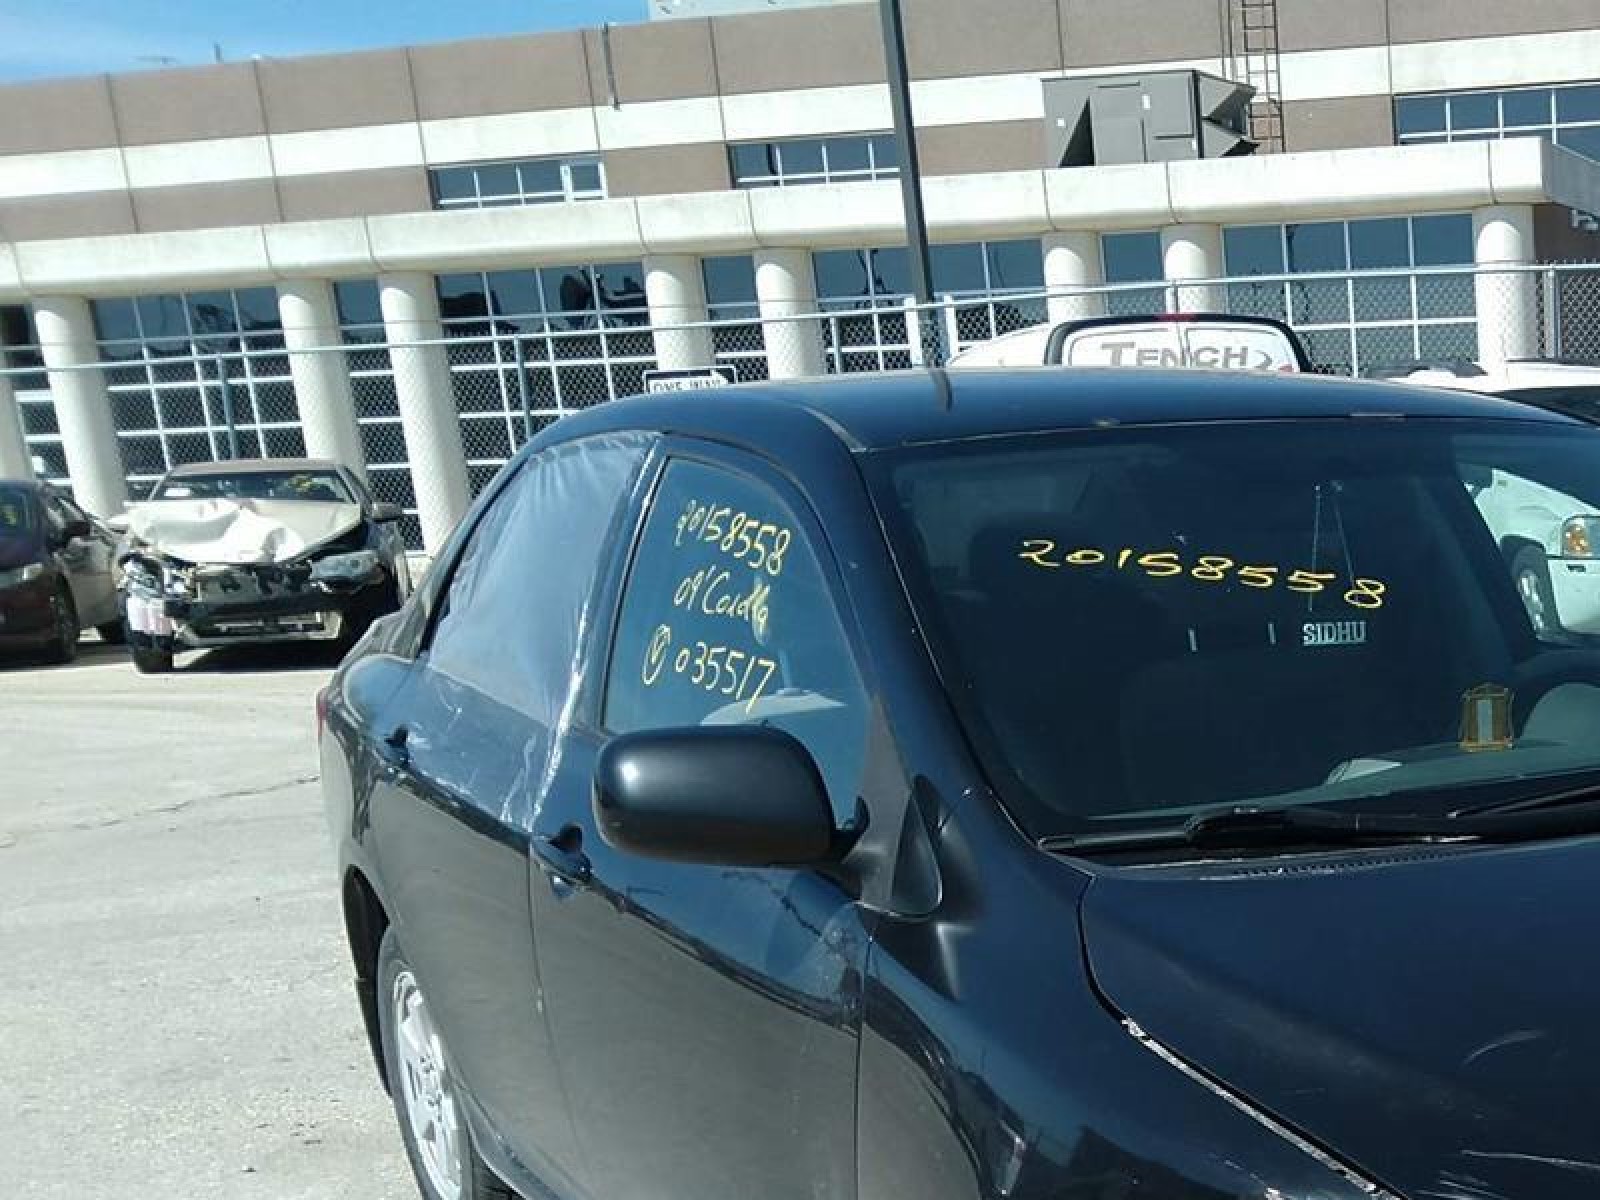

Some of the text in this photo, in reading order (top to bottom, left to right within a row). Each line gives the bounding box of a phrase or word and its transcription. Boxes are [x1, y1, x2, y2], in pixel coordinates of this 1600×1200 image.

[1102, 341, 1249, 368] TENCH
[1018, 538, 1388, 610] 20158558
[1301, 620, 1368, 646] SIDHU
[675, 641, 777, 714] 035517
